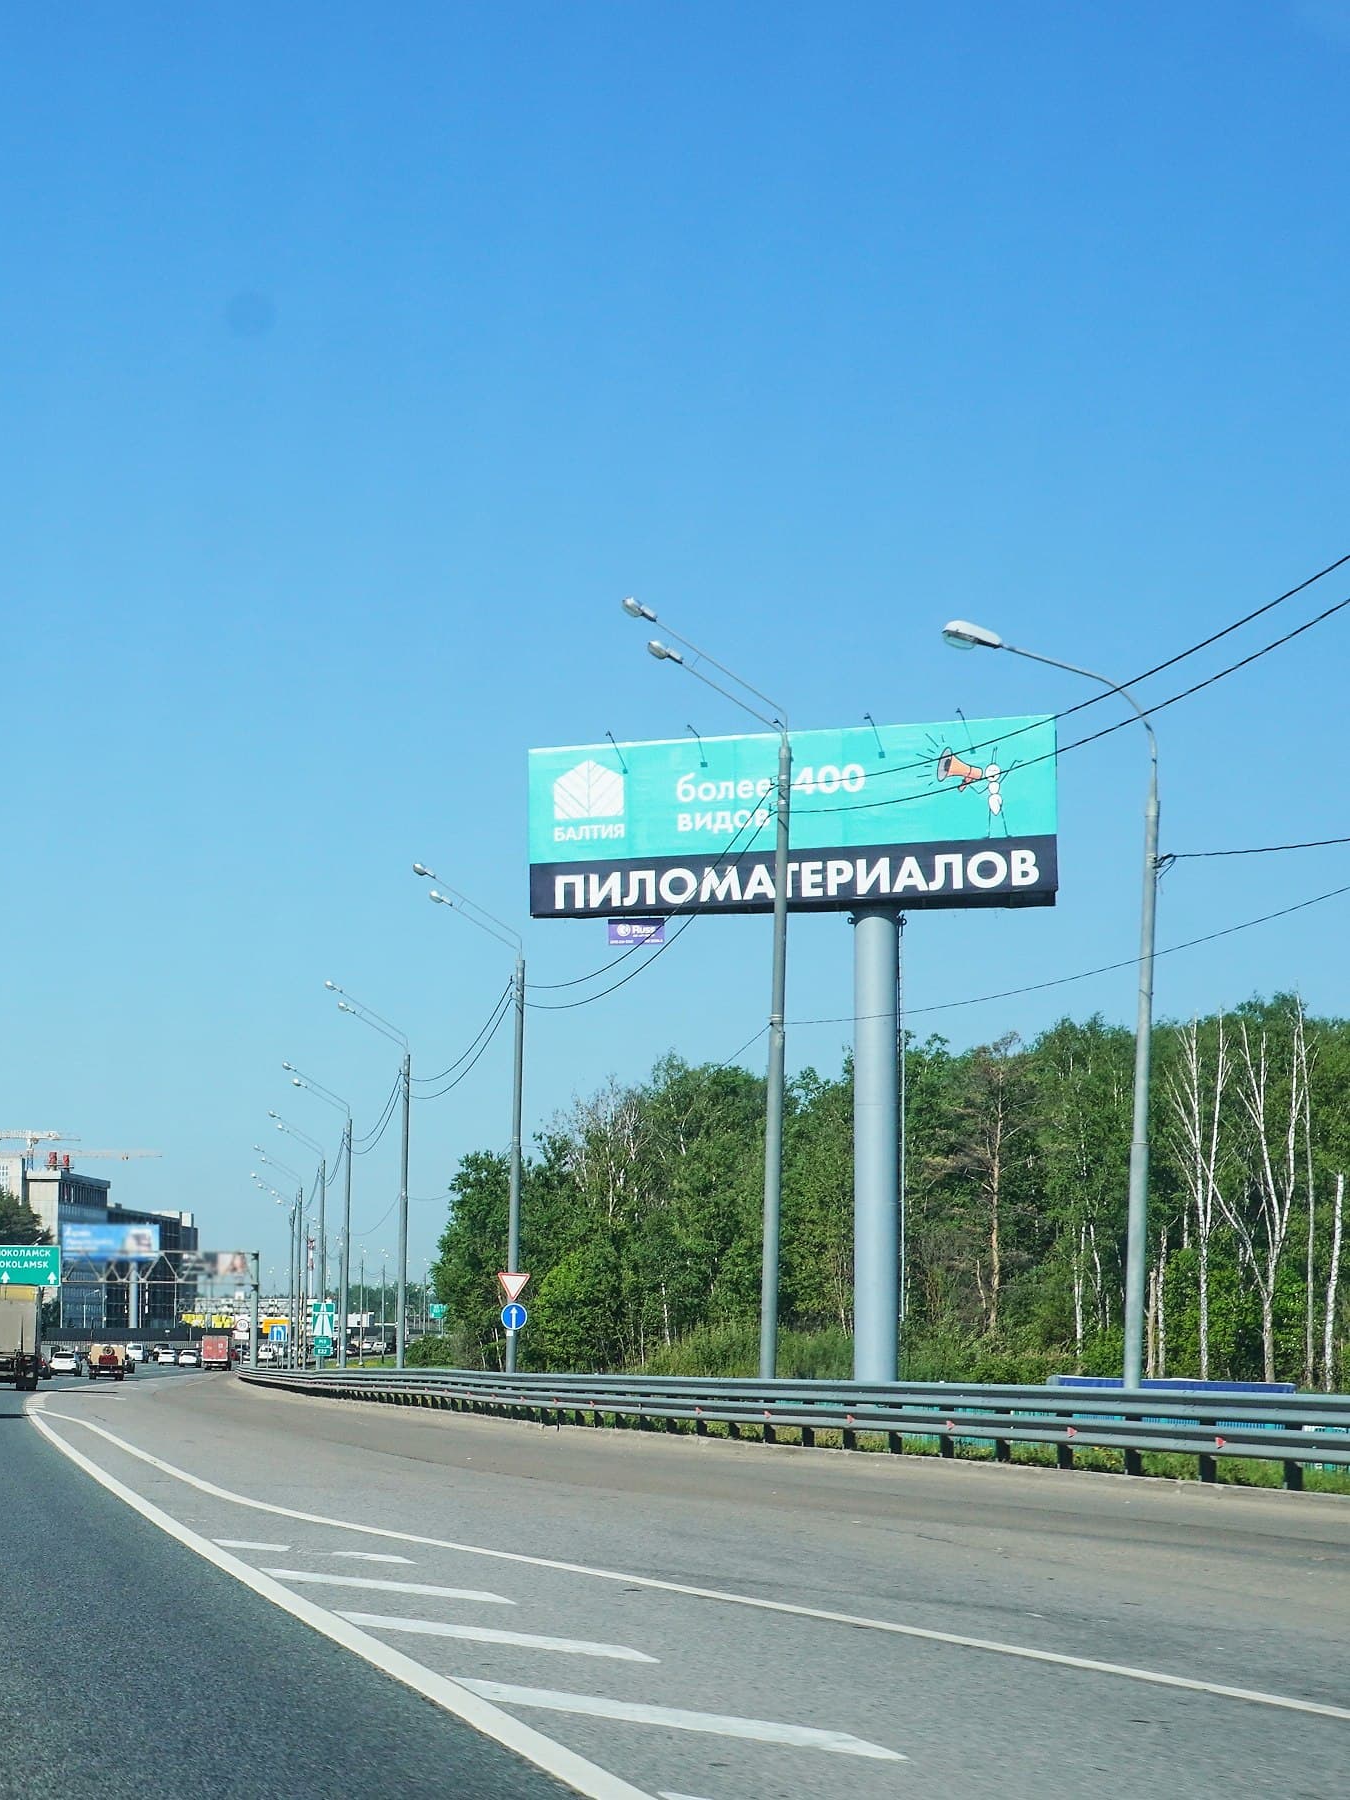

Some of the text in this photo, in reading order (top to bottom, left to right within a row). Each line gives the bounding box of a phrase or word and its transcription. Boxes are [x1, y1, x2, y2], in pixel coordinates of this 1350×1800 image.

[676, 763, 866, 801] более 400
[553, 822, 626, 843] БАЛТИЯ
[676, 808, 771, 834] видов
[553, 849, 1040, 910] ПИЛОМАТЕРИАЛОВ
